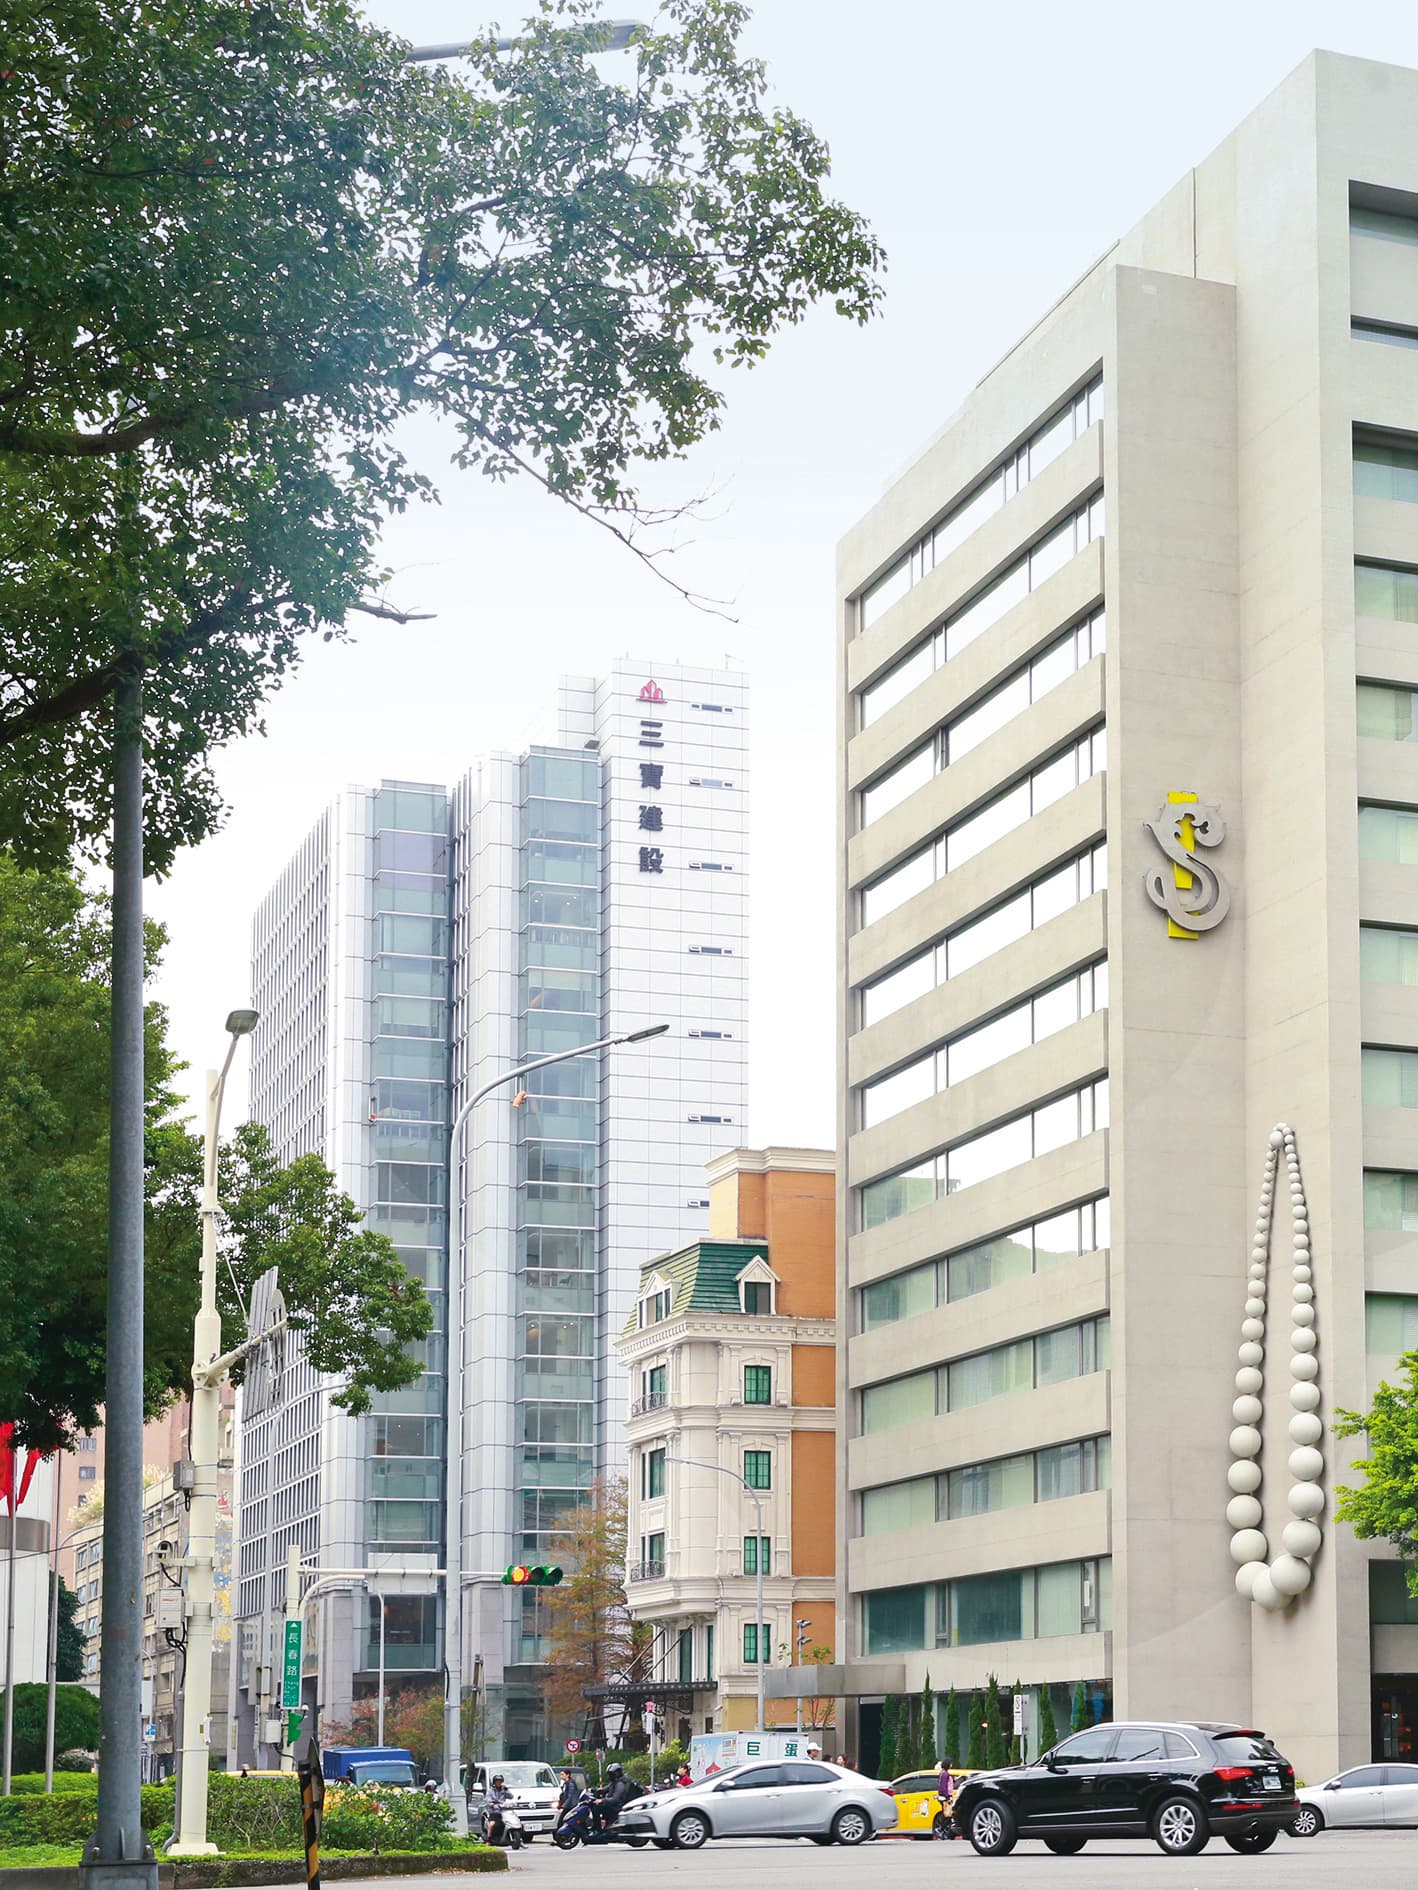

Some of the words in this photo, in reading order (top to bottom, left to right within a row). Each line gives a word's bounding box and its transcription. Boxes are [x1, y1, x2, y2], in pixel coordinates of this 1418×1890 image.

[638, 719, 665, 874] 三寶建設
[287, 1632, 299, 1677] 長春路
[747, 1741, 799, 1758] 巨蛋
